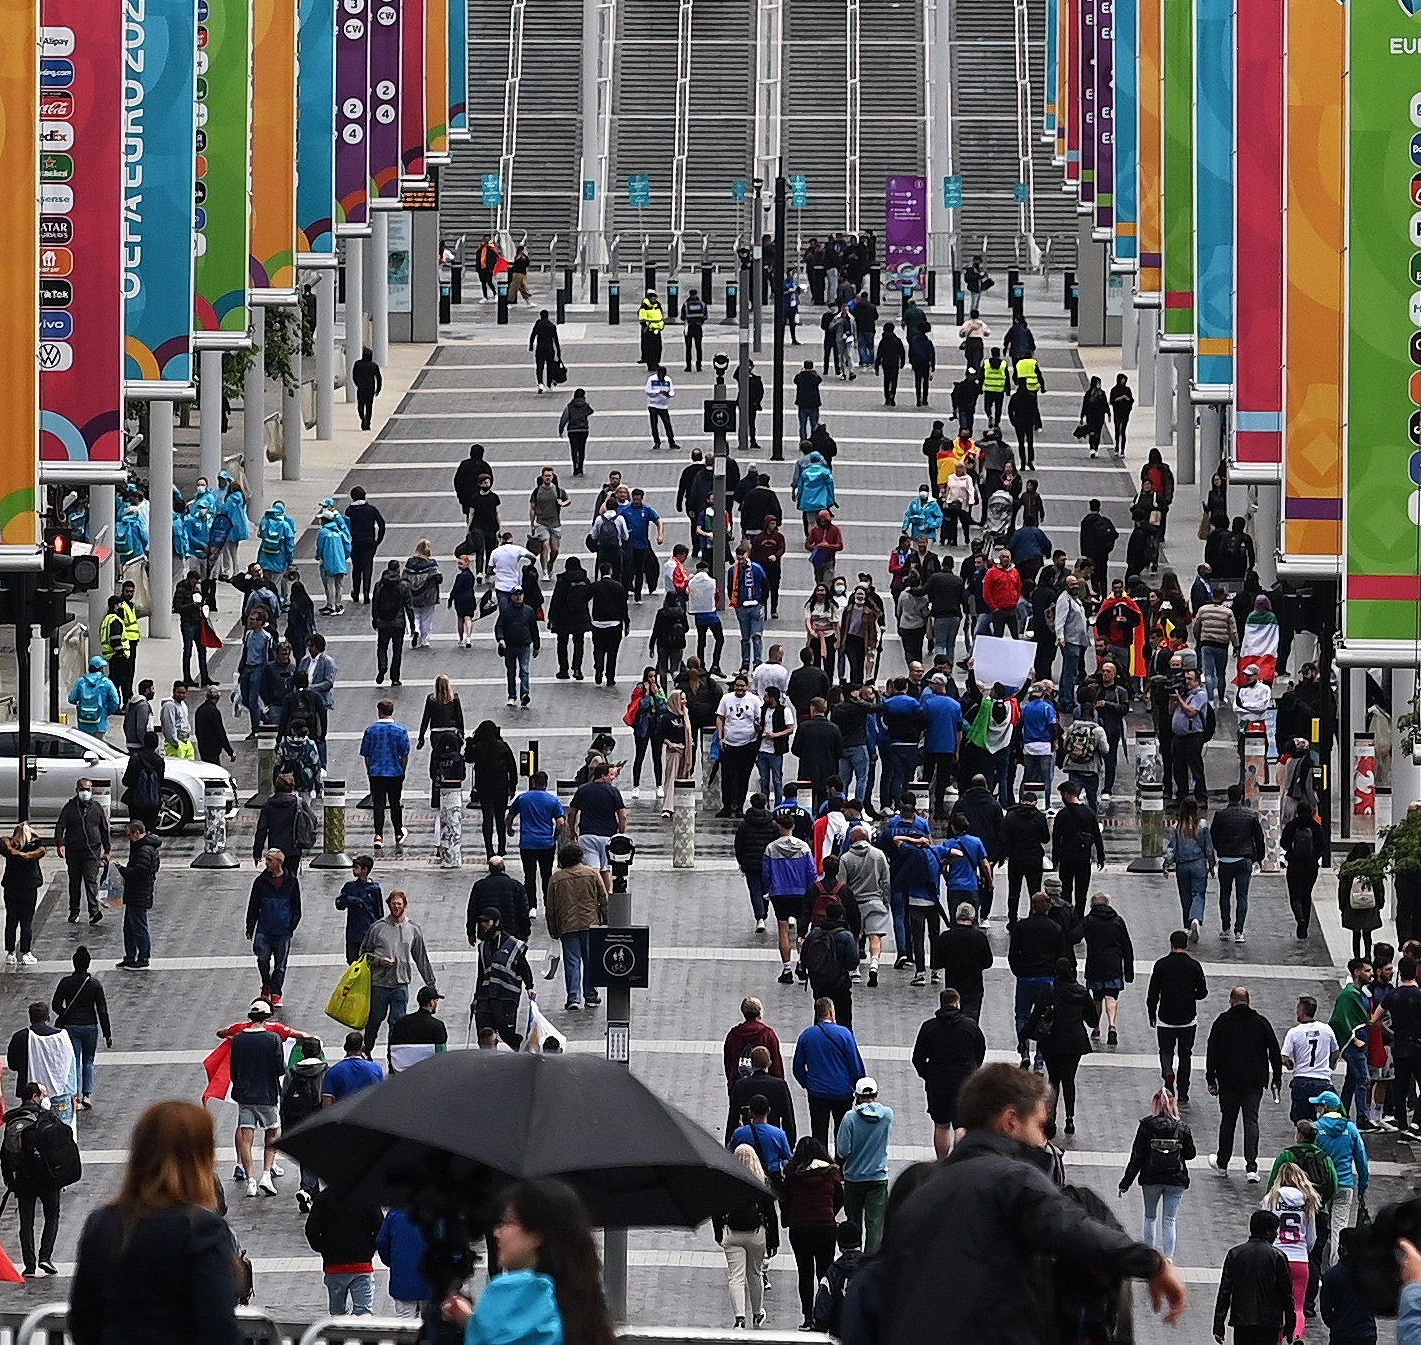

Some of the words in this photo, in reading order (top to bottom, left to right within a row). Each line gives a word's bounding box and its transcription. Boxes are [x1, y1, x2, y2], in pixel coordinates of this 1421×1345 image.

[350, 0, 358, 8] 3
[379, 12, 394, 20] CW
[345, 25, 362, 34] CW
[382, 86, 390, 95] 2
[349, 105, 357, 113] 2
[382, 110, 390, 118] 4
[349, 130, 357, 138] 4
[40, 222, 68, 232] ATAR
[1309, 1039, 1318, 1067] 7
[1280, 1212, 1301, 1244] 6
